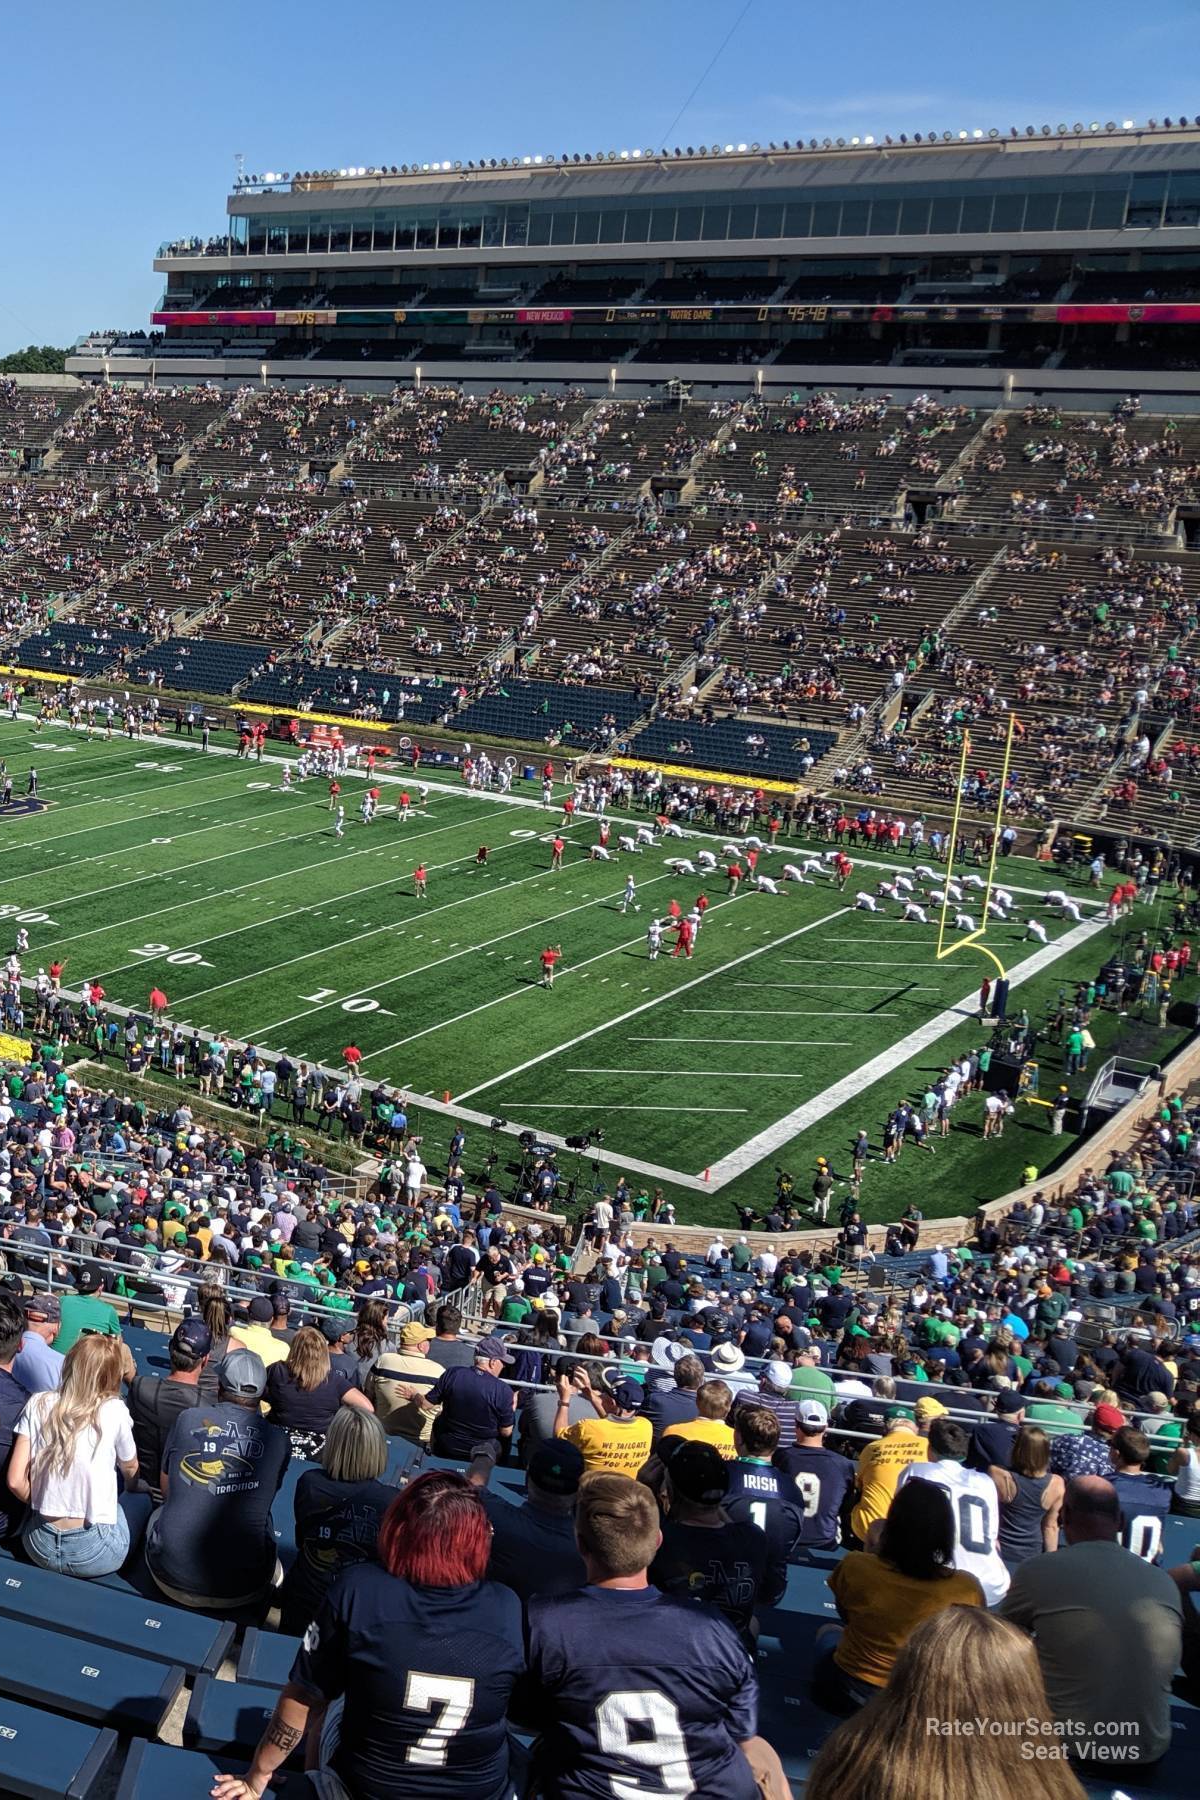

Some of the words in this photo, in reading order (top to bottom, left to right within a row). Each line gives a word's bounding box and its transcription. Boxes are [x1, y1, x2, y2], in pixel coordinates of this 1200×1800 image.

[297, 313, 316, 324] VS
[526, 311, 541, 321] NEW
[542, 310, 565, 320] MEXICO
[605, 309, 616, 322] 0
[670, 309, 692, 320] NOTRE
[693, 309, 713, 320] DAME
[757, 307, 768, 321] 0
[787, 307, 828, 321] 45:48
[128, 943, 202, 965] 20
[298, 988, 380, 1013] 10
[203, 1441, 217, 1453] 19
[602, 1441, 612, 1449] WE
[616, 1441, 647, 1450] TAILGATE
[902, 1449, 924, 1457] THAN
[603, 1460, 620, 1468] YOU
[216, 1481, 260, 1495] TRADITION
[743, 1473, 778, 1493] IRISH
[795, 1471, 821, 1518] 9
[749, 1501, 767, 1532] 1
[318, 1526, 332, 1539] 19
[82, 1667, 99, 1677] 23
[402, 1670, 476, 1766] 7
[595, 1690, 697, 1800] 9
